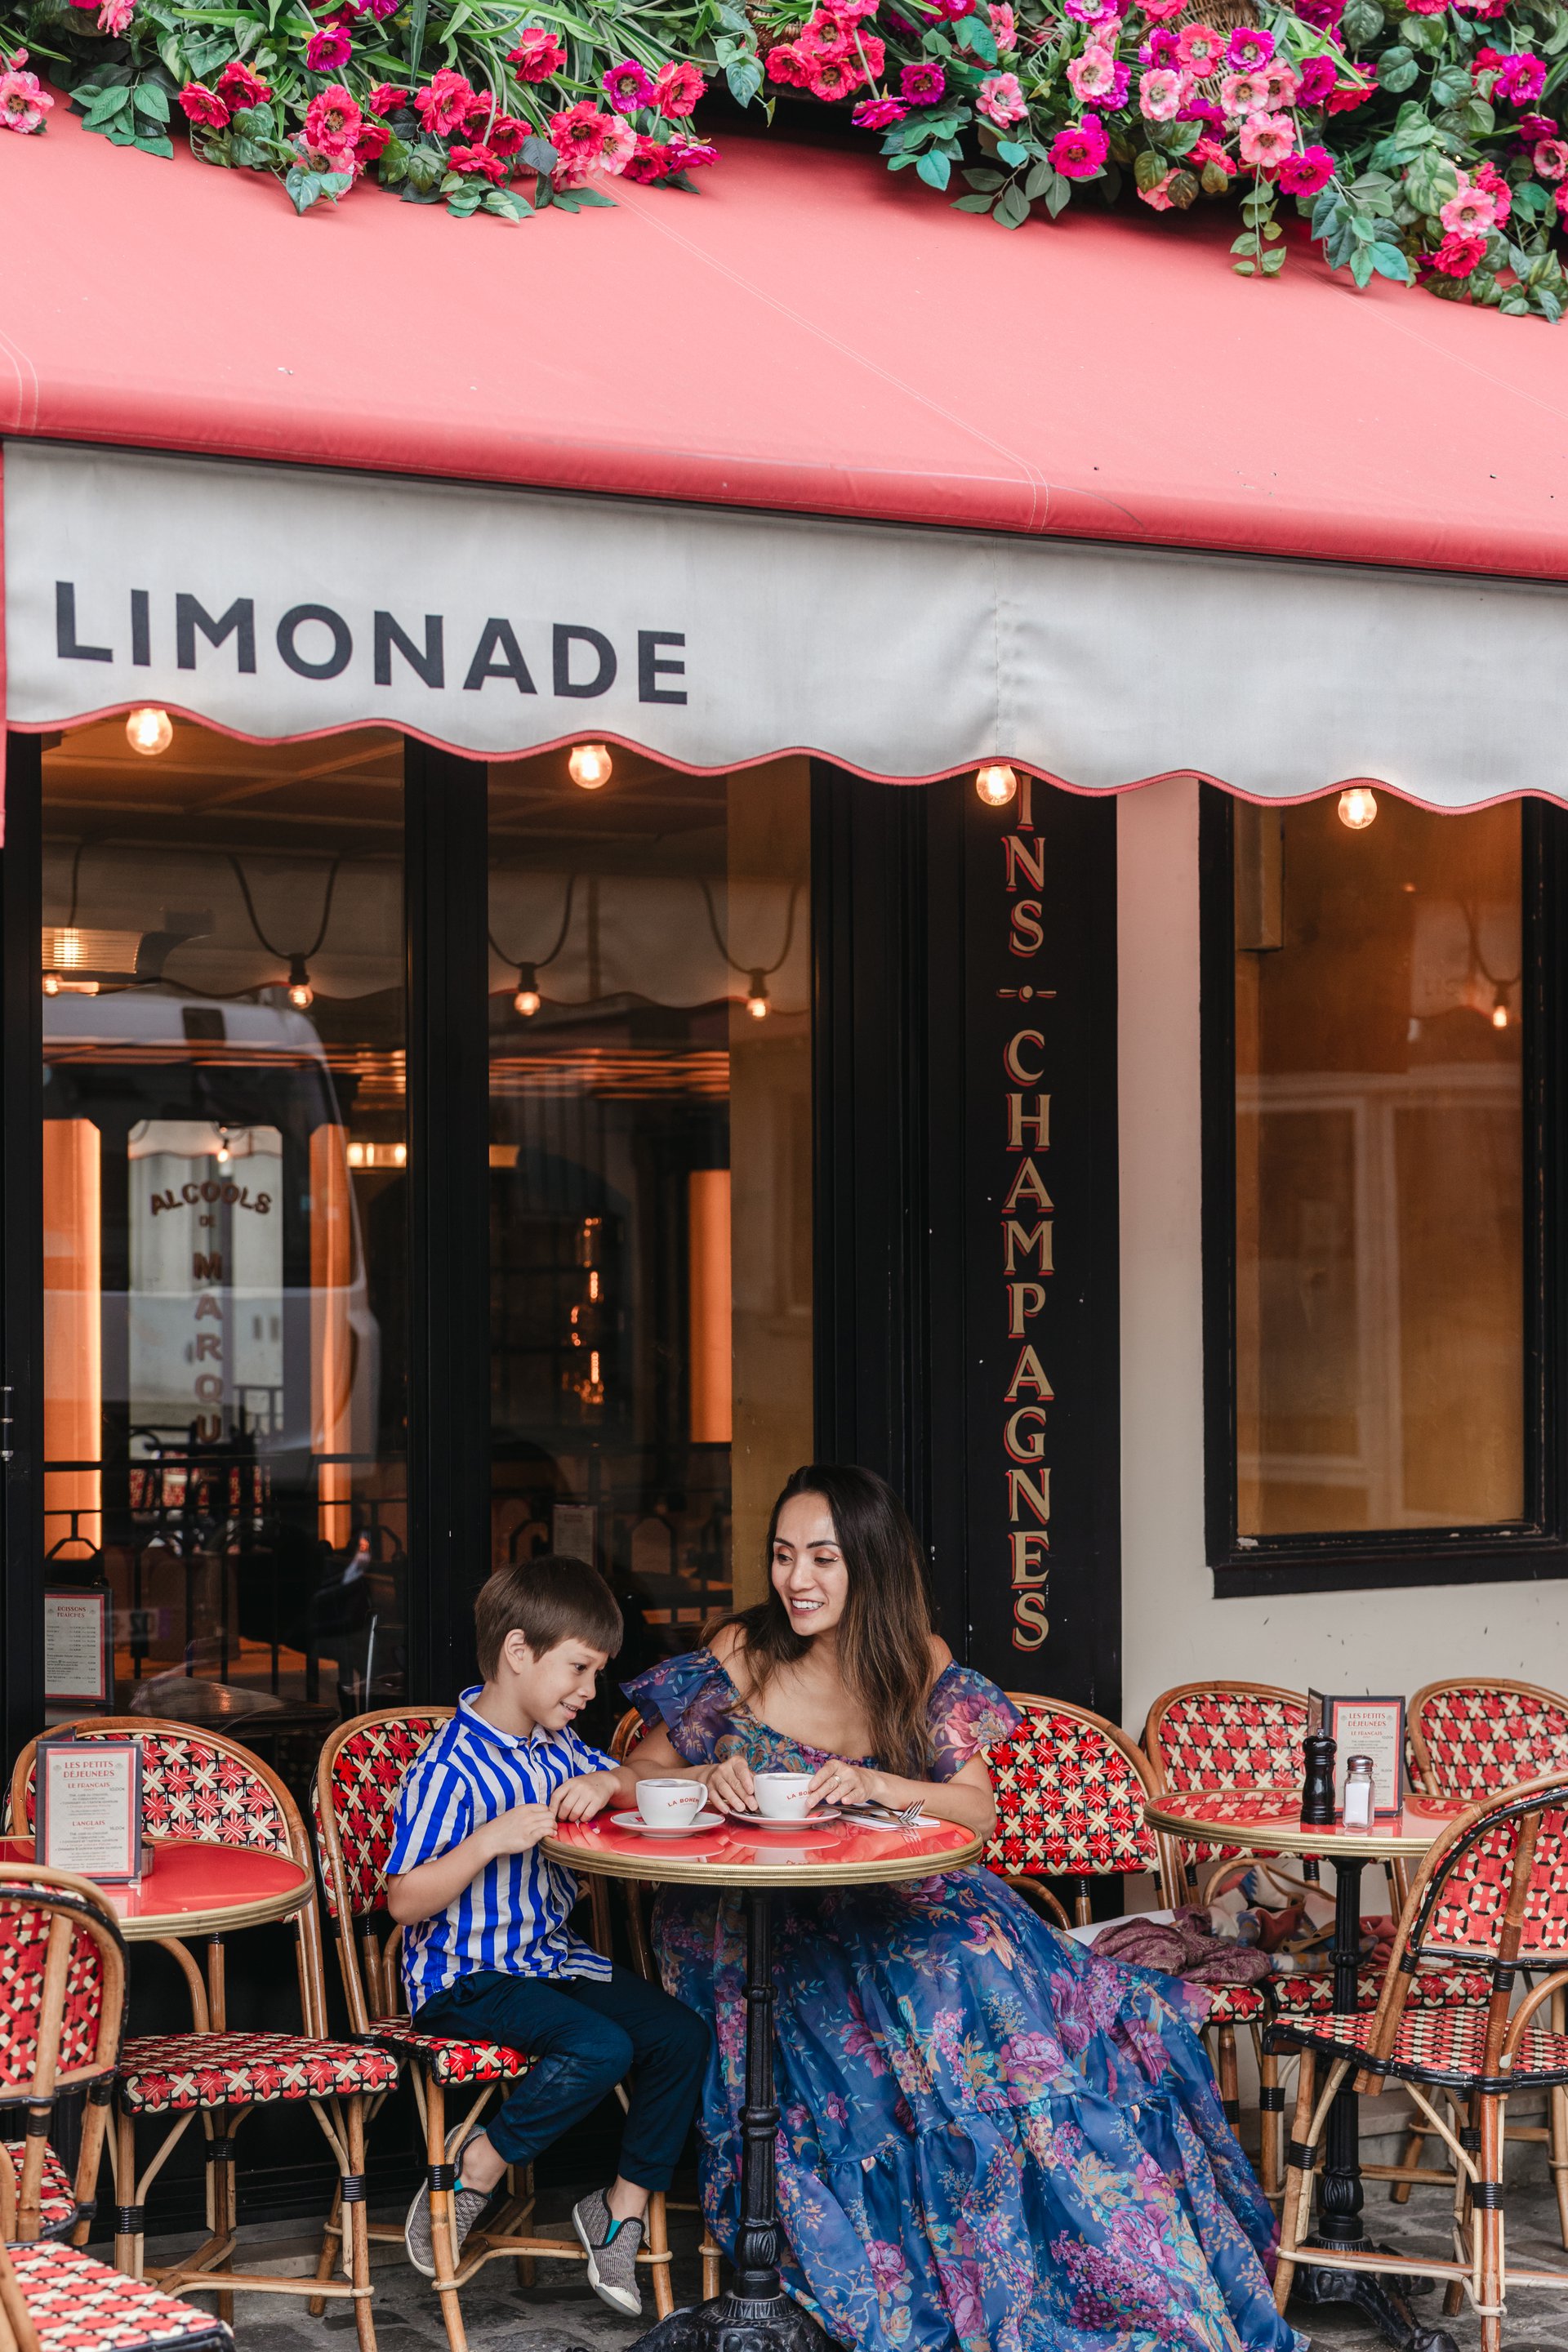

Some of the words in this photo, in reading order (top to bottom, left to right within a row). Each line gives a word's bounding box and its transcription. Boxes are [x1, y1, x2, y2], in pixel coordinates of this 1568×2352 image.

[56, 581, 688, 705] LIMONADE
[1000, 774, 1046, 957] INS
[150, 1180, 272, 1215] ALCOOLS
[1001, 1029, 1055, 1651] CHAMPAGNES
[63, 1770, 114, 1778] DÉJEUNERS
